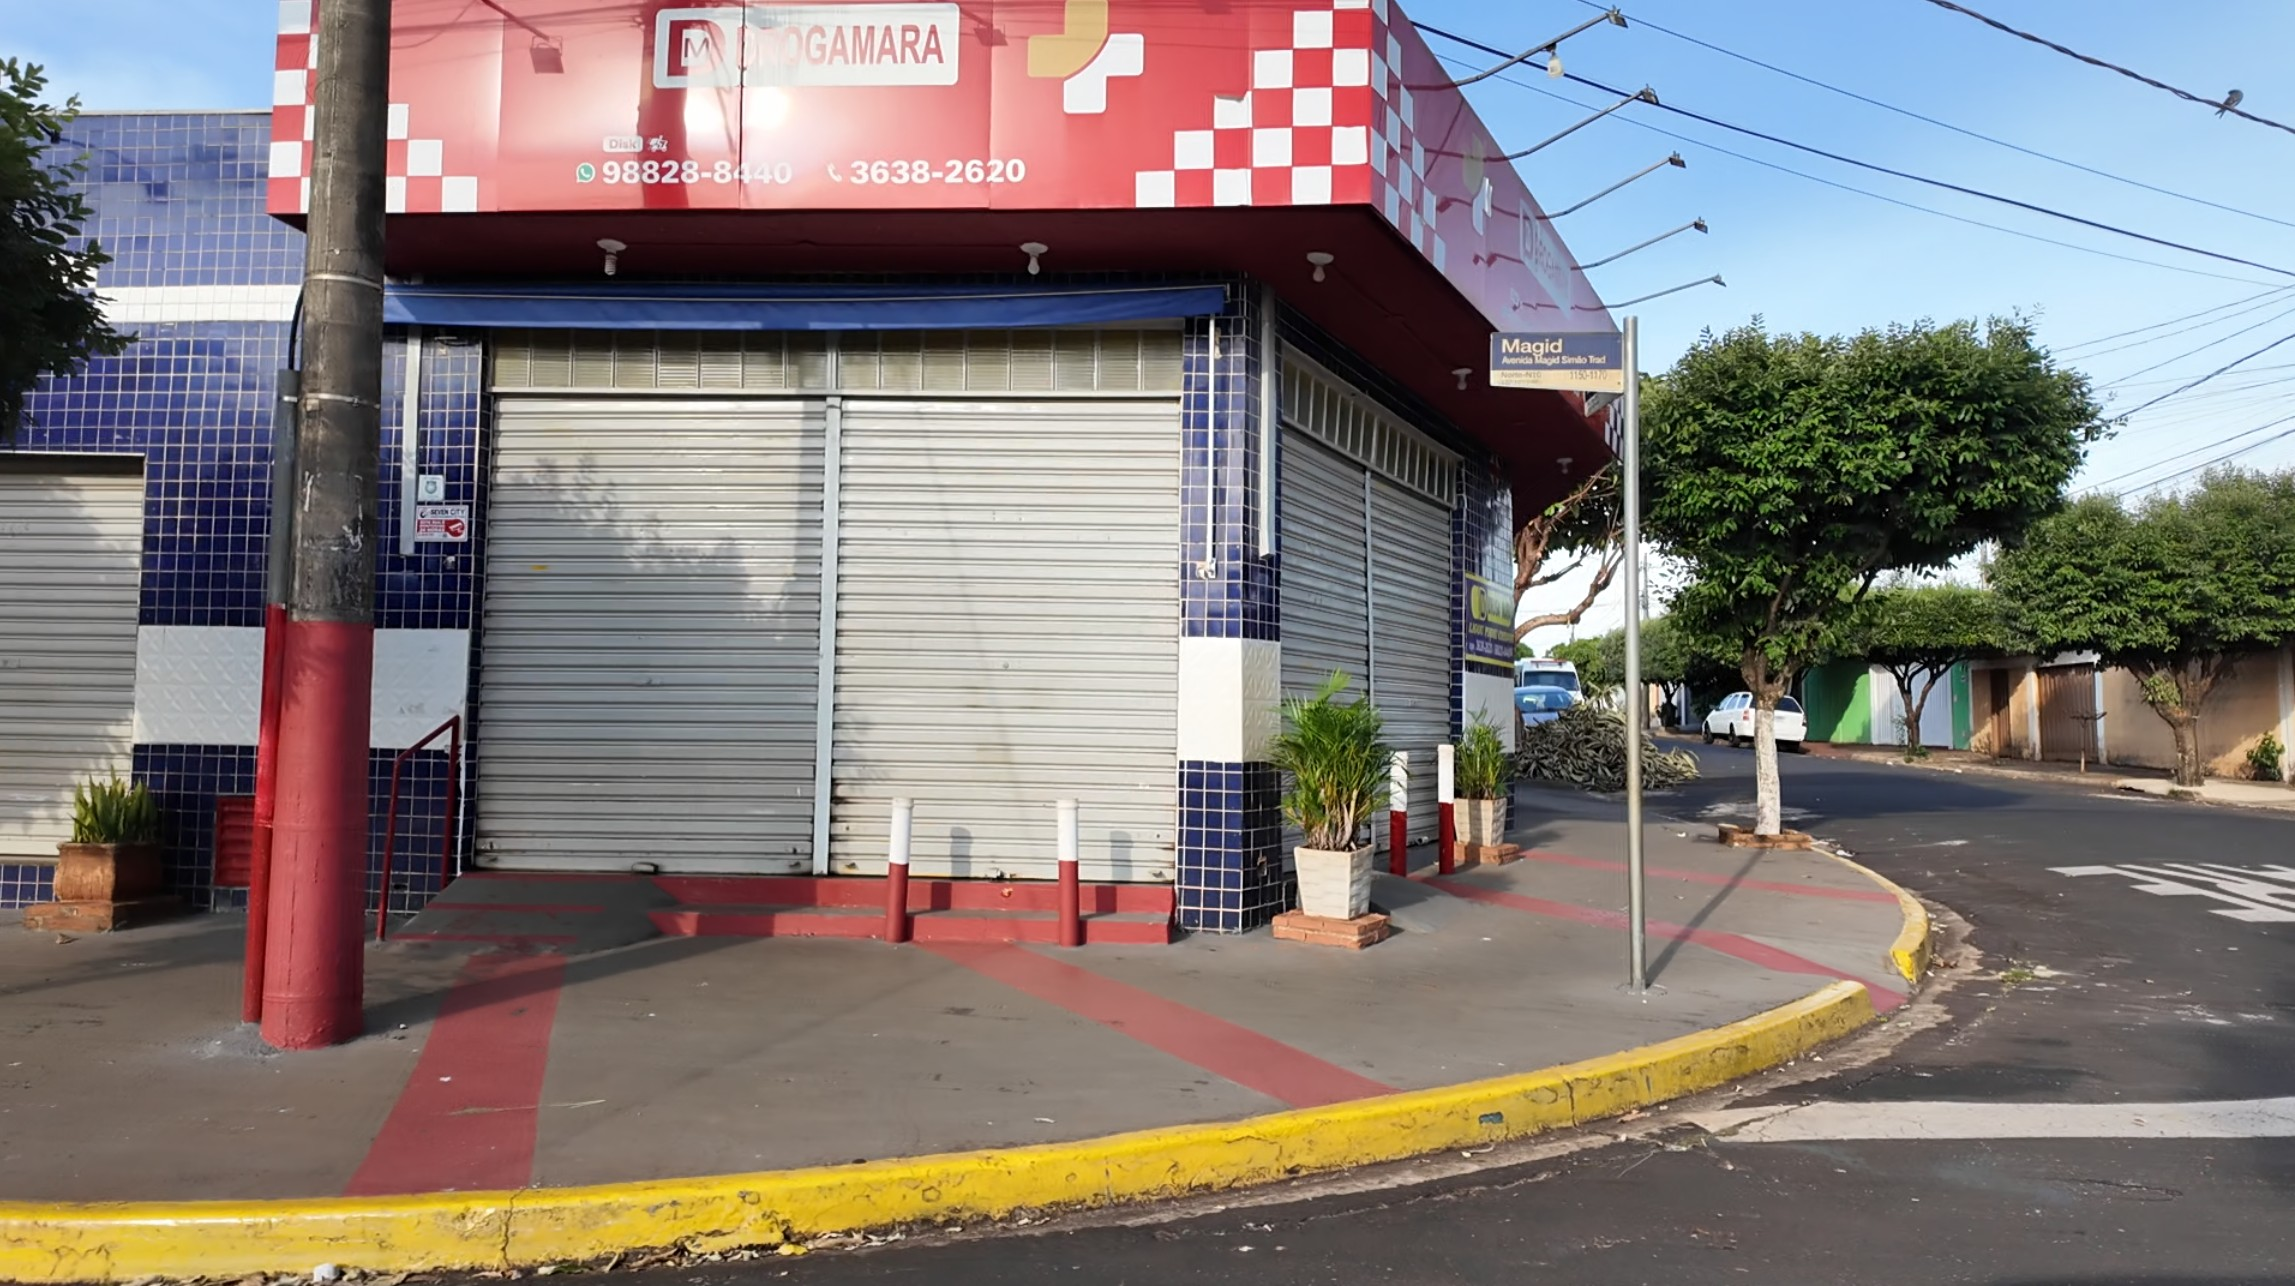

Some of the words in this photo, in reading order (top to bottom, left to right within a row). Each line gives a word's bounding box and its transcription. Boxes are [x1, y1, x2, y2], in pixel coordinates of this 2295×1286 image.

[736, 24, 944, 67] DOGAMARA
[608, 138, 638, 150] Disk
[602, 159, 792, 184] 98828-8440
[850, 158, 1026, 184] 3638-2620
[1501, 338, 1563, 357] Magid
[1502, 355, 1534, 365] Avenida
[1534, 355, 1560, 366] Magid
[1588, 355, 1606, 365] Trad
